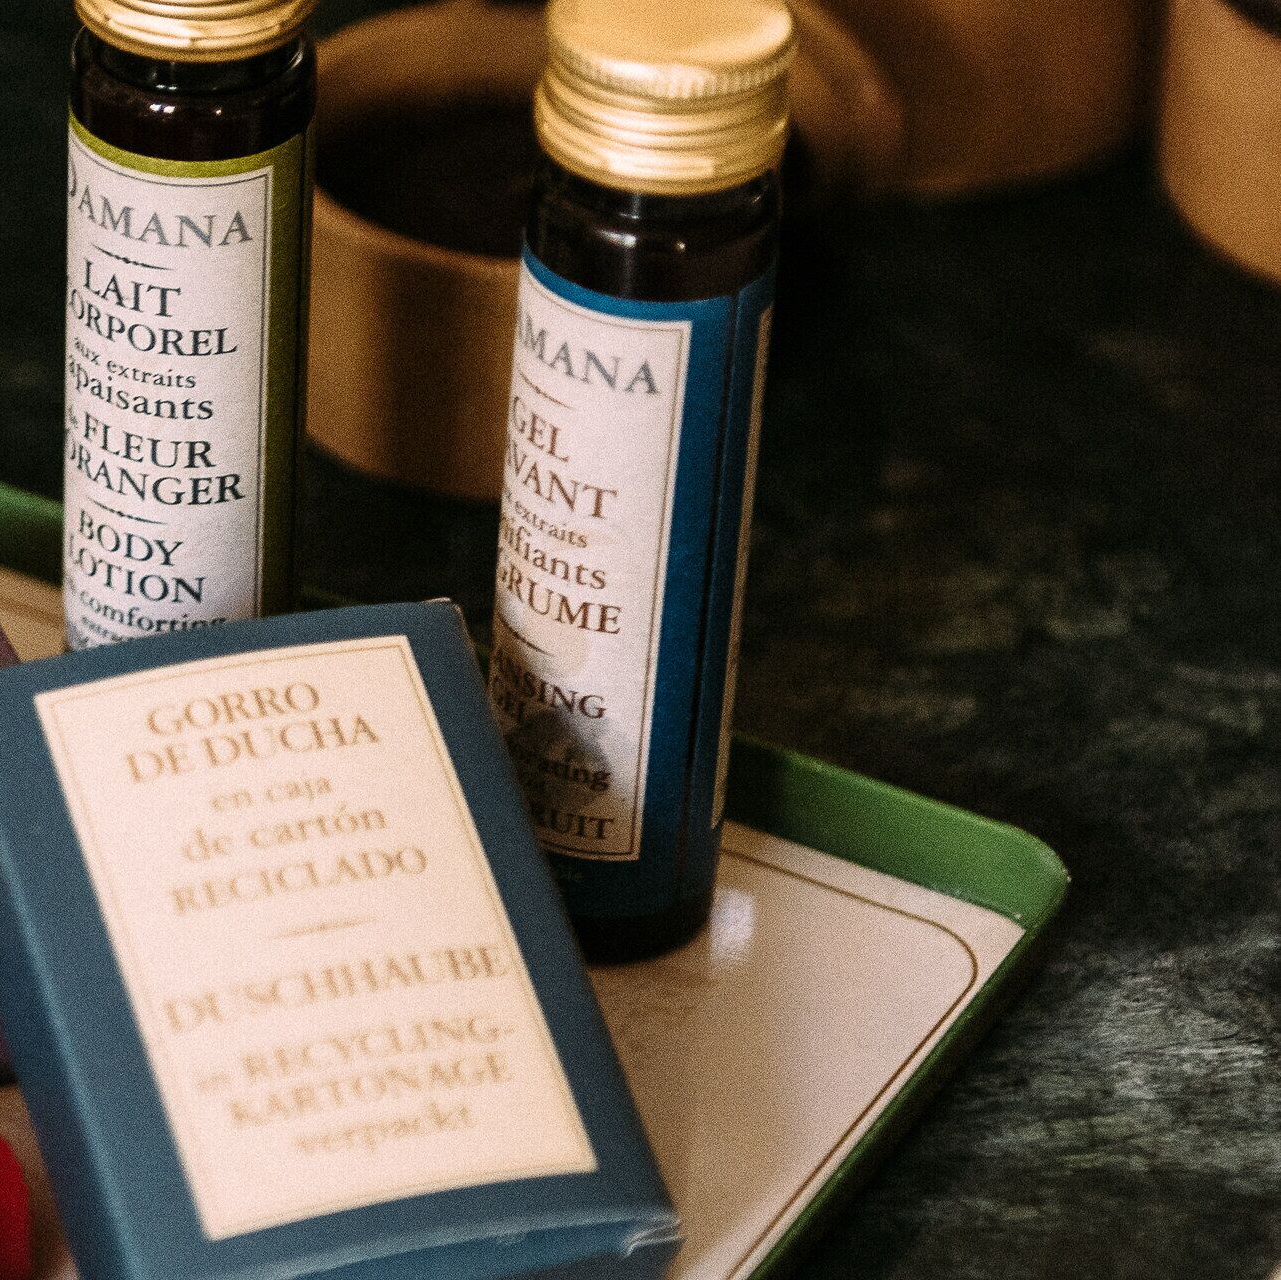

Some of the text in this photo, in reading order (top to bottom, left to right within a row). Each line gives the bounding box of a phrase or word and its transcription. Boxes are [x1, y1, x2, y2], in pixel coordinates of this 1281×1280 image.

[83, 257, 181, 318] LAIT
[68, 287, 238, 357] ORPOREL
[518, 308, 661, 396] MANA
[106, 359, 197, 389] extraits
[83, 410, 217, 470] FLEUR
[506, 438, 617, 520] VANT
[78, 508, 184, 567] BODY
[503, 517, 607, 591] ifiants
[514, 499, 588, 549] extraits
[498, 563, 623, 636] RUME
[146, 681, 320, 738] GORRO
[126, 713, 381, 784] DE DUCHA
